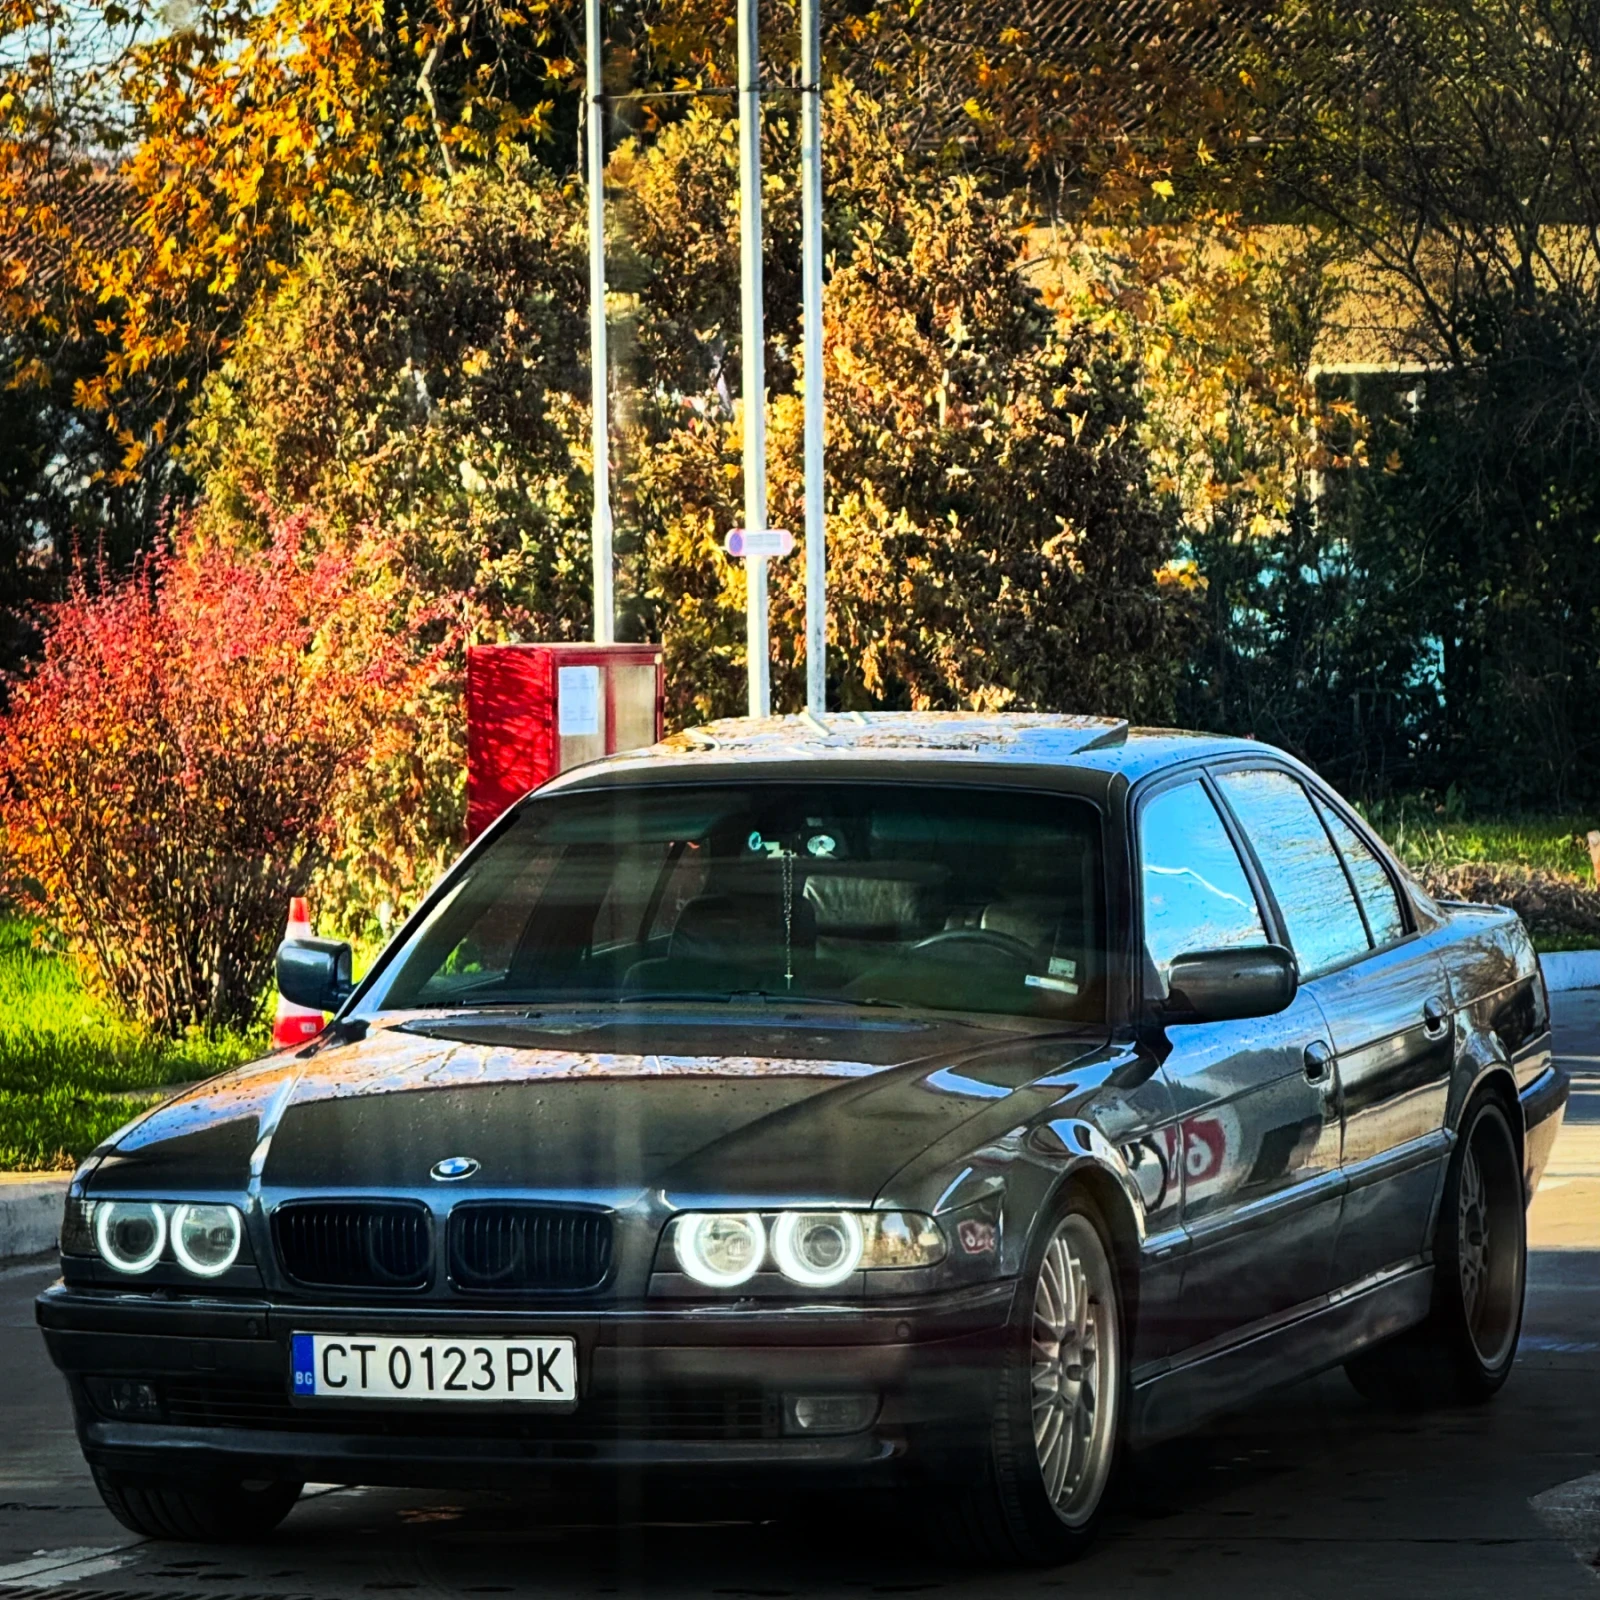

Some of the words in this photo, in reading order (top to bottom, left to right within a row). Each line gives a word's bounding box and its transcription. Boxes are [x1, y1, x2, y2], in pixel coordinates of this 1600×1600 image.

[295, 1371, 313, 1385] BG
[322, 1343, 376, 1389] CT
[388, 1345, 496, 1391] 0123
[506, 1347, 564, 1393] PK
